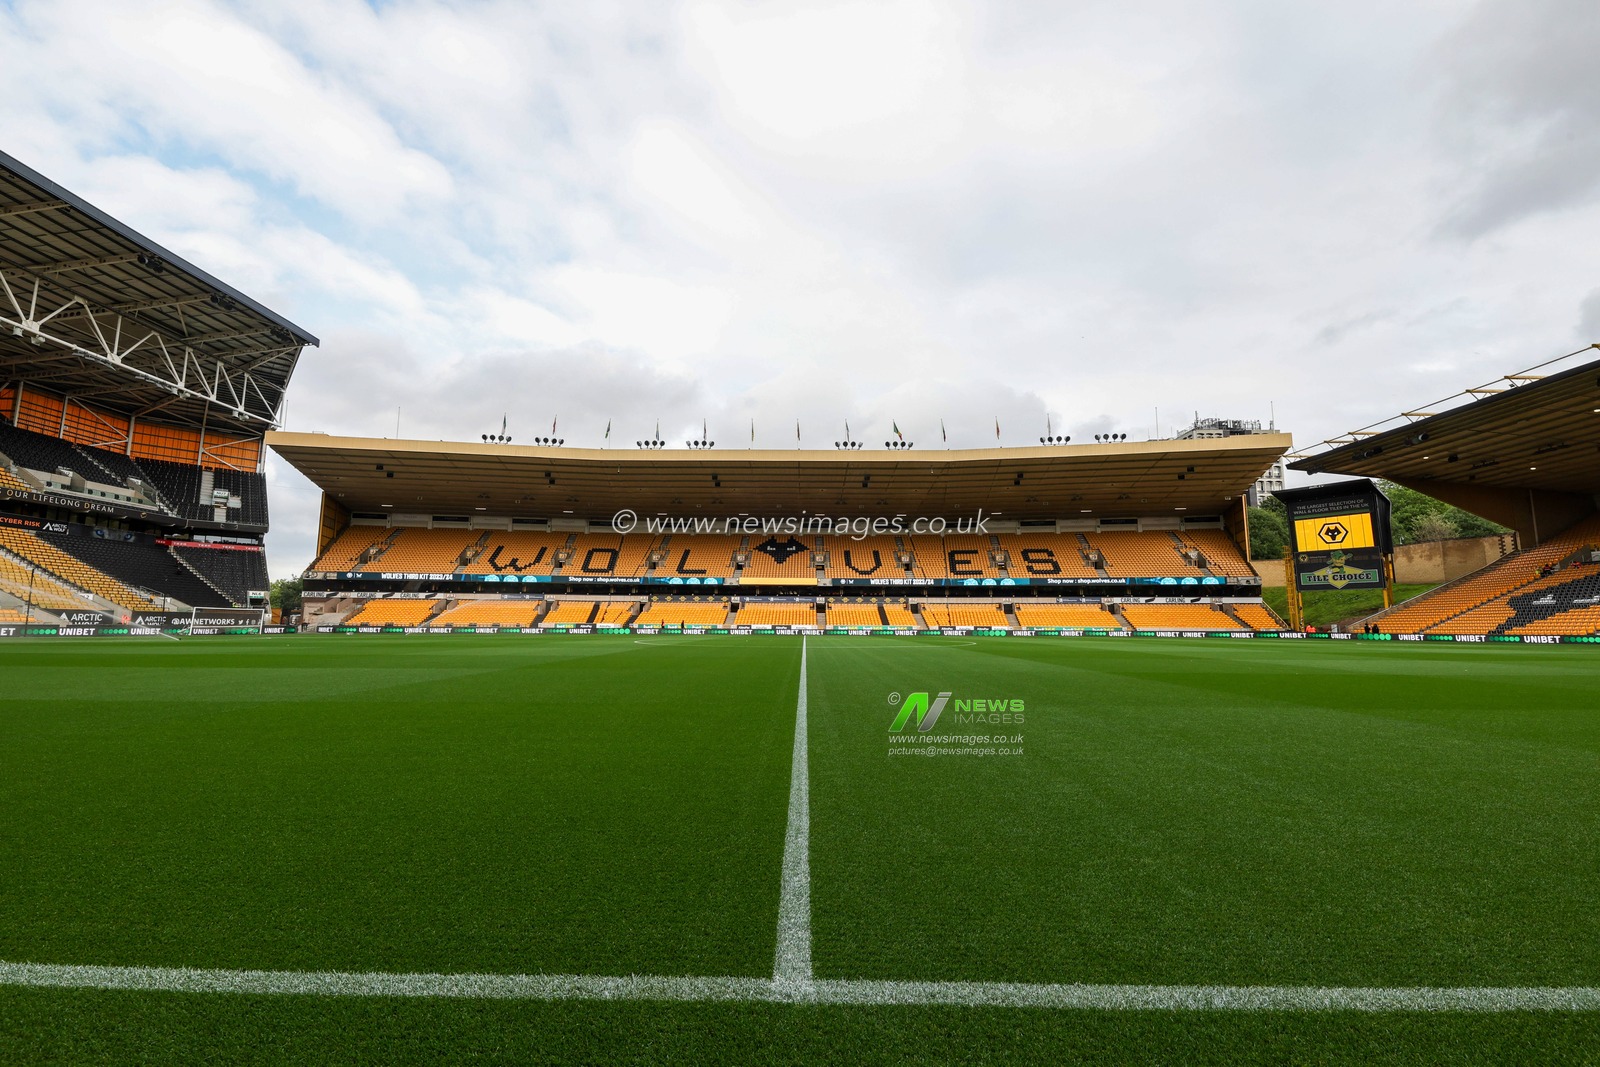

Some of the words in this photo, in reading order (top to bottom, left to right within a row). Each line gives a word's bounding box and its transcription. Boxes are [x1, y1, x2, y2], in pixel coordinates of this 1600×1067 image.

[7, 489, 29, 499] OUR
[33, 495, 80, 508] LIFELONG
[84, 503, 114, 513] DREAM
[0, 517, 23, 525] CYBER
[1306, 574, 1329, 582] TILE
[1332, 573, 1372, 581] CHOICE
[71, 613, 103, 621] ARCTIC
[59, 628, 95, 636] UNIBET
[1523, 635, 1560, 643] UNIBET
